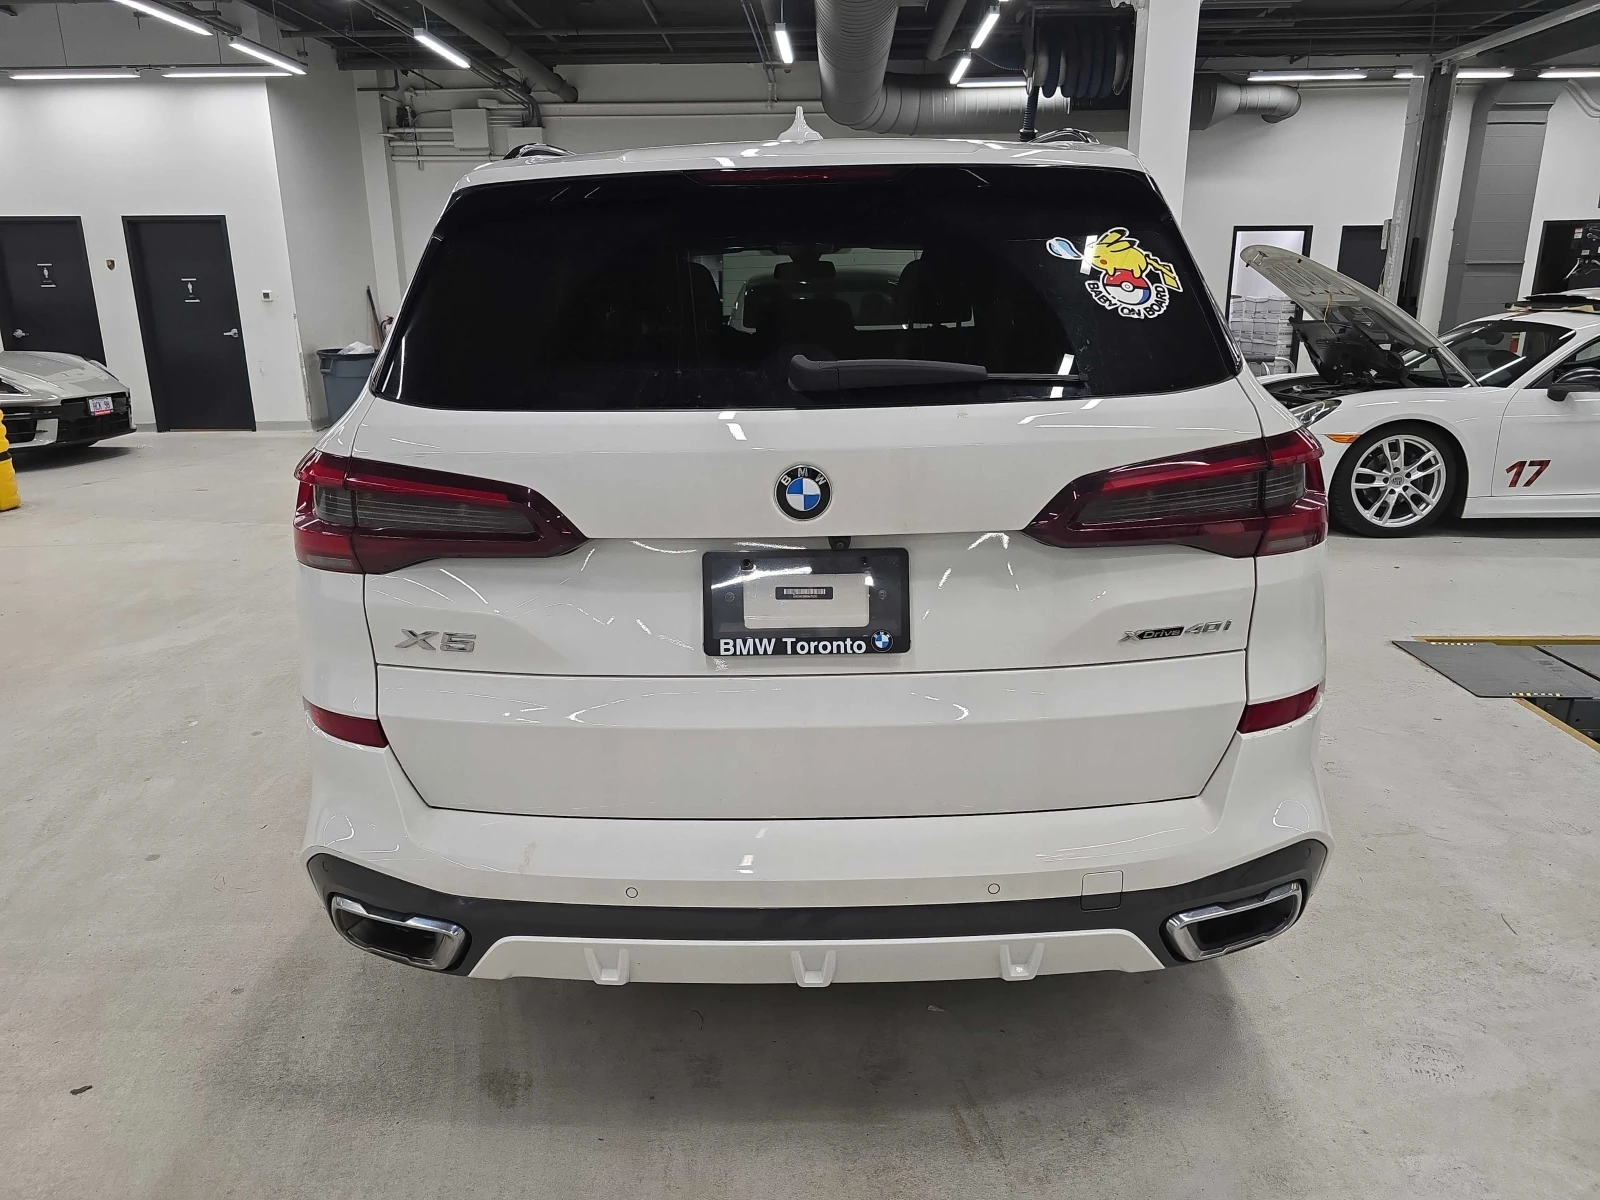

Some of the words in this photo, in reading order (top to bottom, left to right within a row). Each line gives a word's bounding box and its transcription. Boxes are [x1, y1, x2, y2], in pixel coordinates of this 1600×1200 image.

[1087, 282, 1117, 307] BABY
[1120, 306, 1142, 317] ON
[1143, 285, 1167, 316] BOARD
[780, 467, 827, 486] BMW
[1505, 459, 1551, 488] 17
[394, 628, 476, 652] X5
[719, 638, 776, 655] BMW
[782, 637, 867, 654] Toronto
